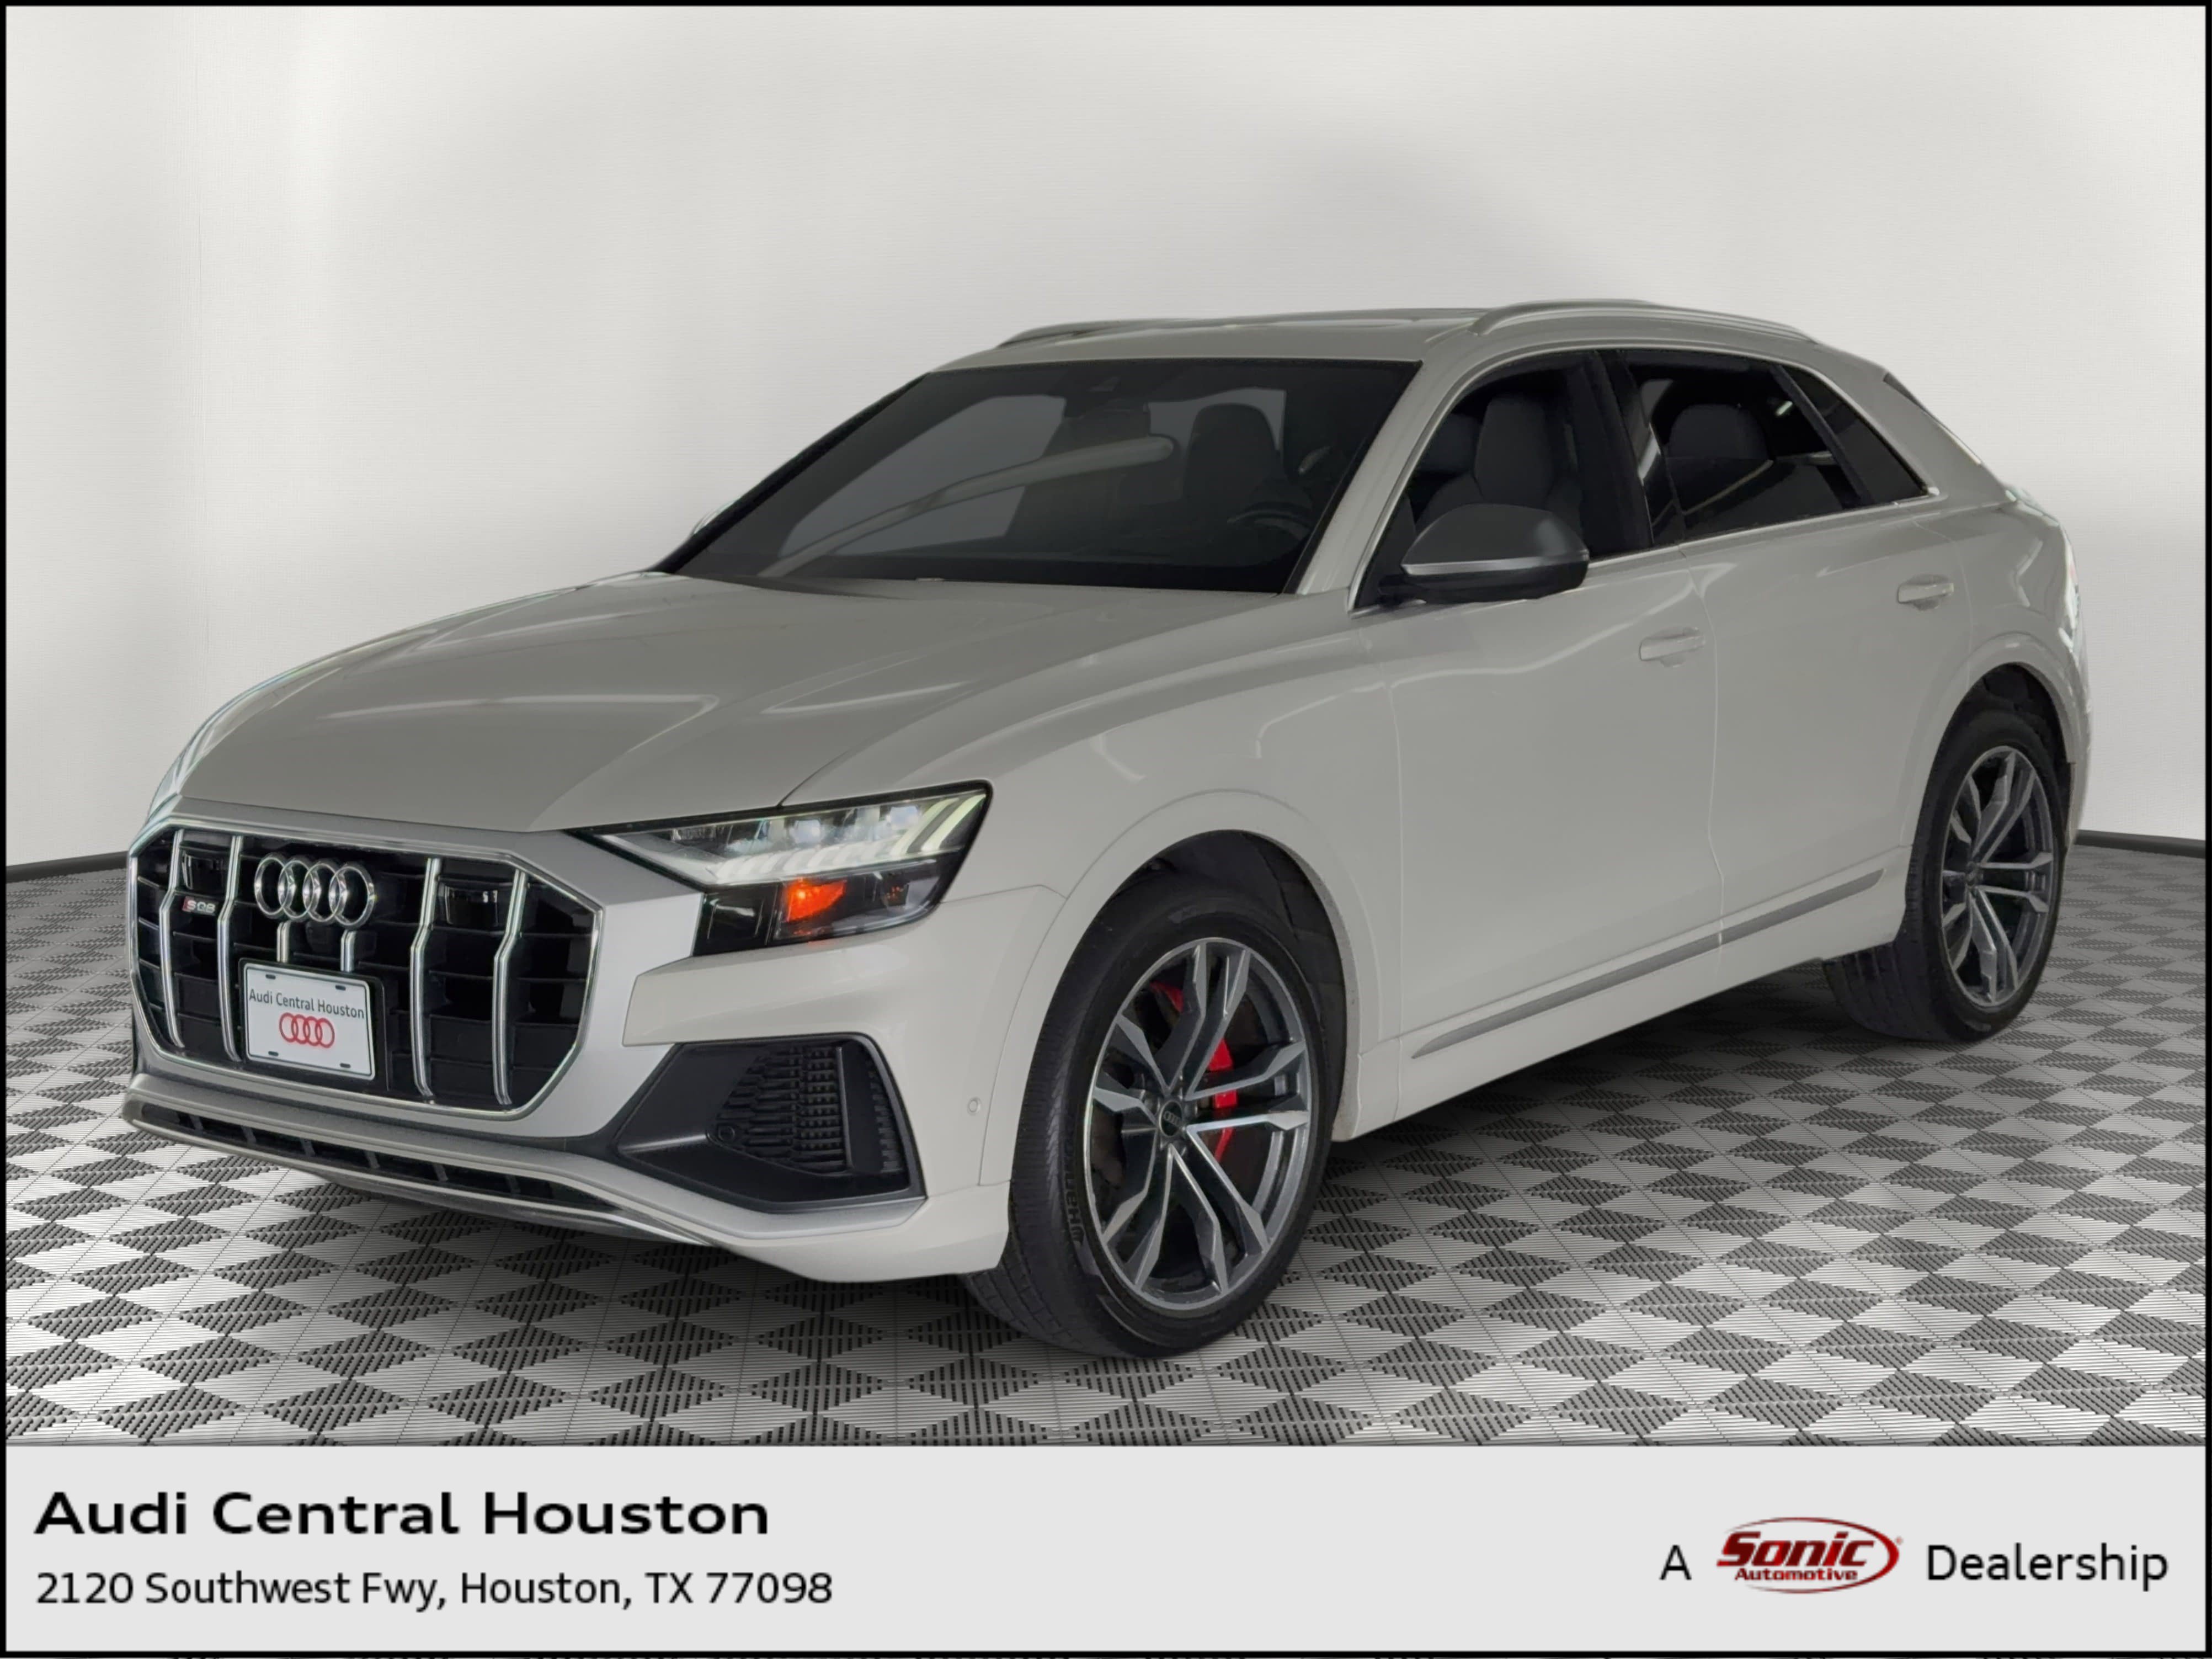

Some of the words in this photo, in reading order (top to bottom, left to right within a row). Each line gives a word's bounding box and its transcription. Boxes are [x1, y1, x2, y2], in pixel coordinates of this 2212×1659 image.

[249, 988, 273, 1004] Audi
[276, 992, 315, 1012] Central
[318, 999, 365, 1019] Houston
